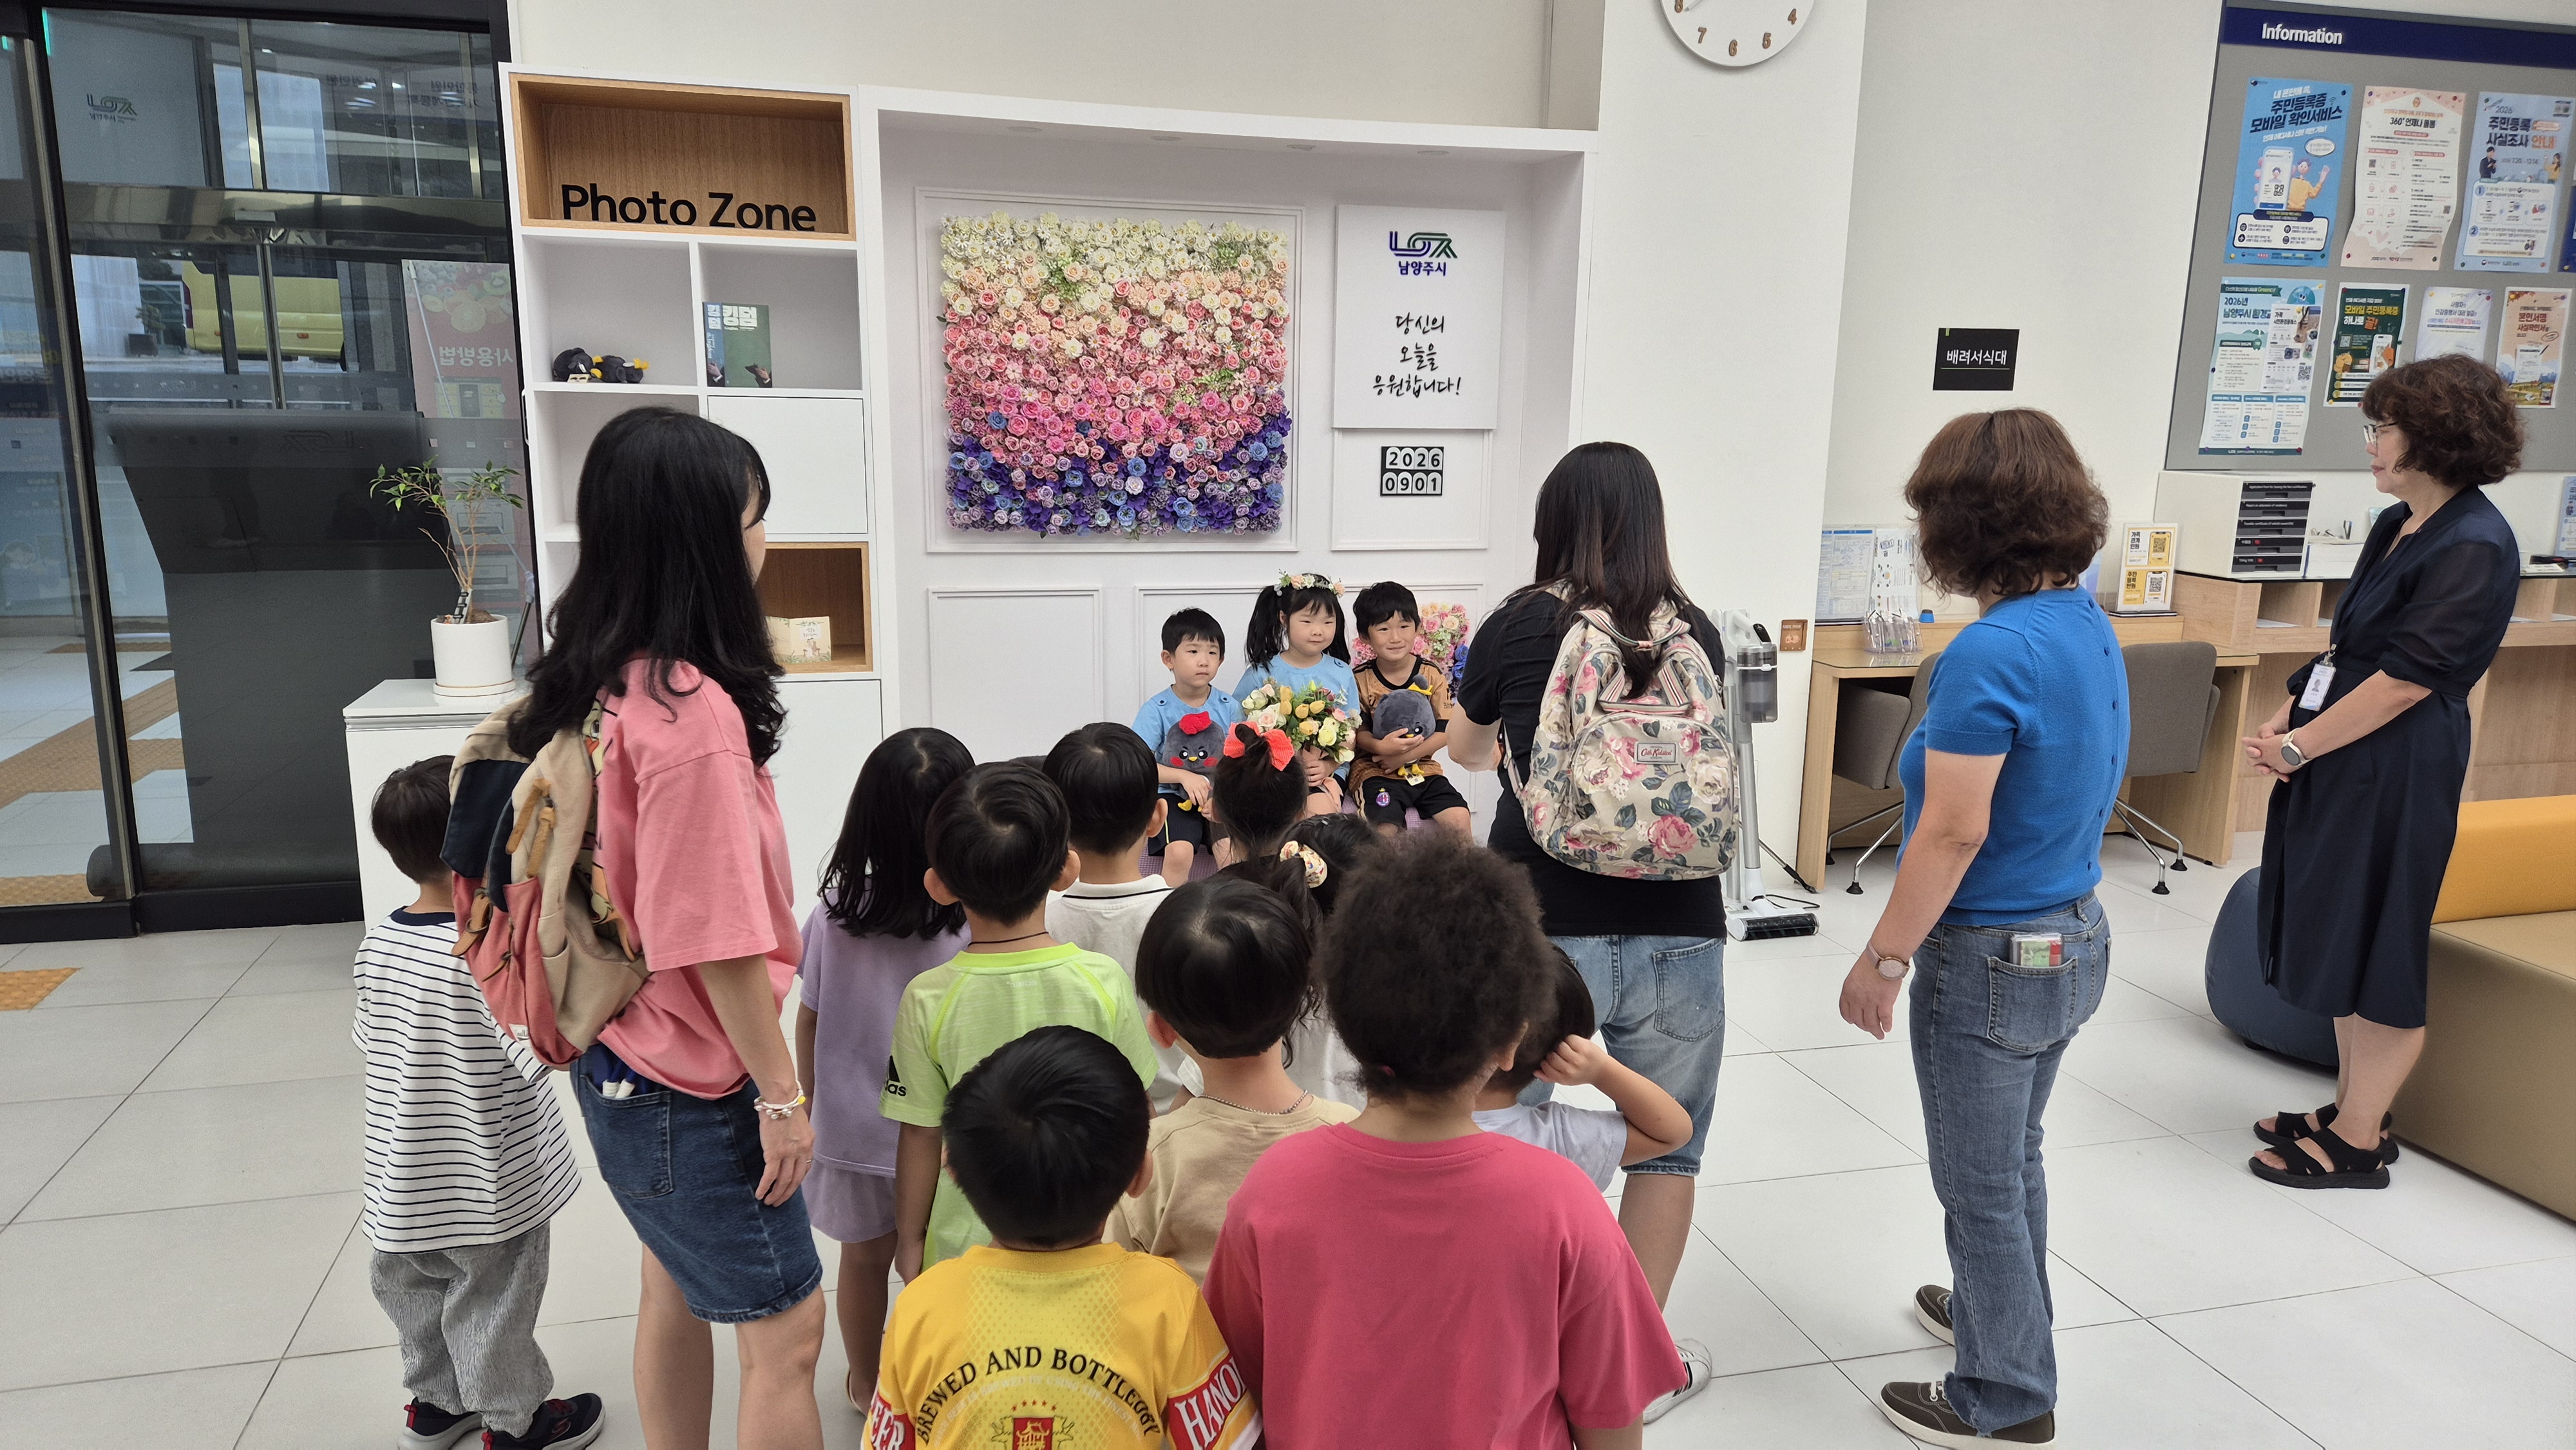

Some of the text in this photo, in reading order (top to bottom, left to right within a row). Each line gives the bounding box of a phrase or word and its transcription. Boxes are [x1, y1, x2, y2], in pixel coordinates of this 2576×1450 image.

[1788, 8, 1797, 25] 4
[1698, 27, 1707, 44] 7
[1762, 32, 1771, 49] 5
[2261, 23, 2344, 46] Information
[1728, 39, 1738, 57] 6
[2271, 92, 2327, 115] 주민등록증
[2249, 106, 2342, 133] 모바일 확인서비스
[2405, 118, 2423, 127] 언제나
[2488, 116, 2532, 132] 주민등록
[2486, 132, 2555, 149] 사실조사 안내
[562, 183, 817, 232] Photo Zone
[1397, 260, 1447, 277] 남양주시
[2224, 297, 2248, 306] 2026년
[2344, 305, 2399, 315] 모바일 주민등록증
[722, 305, 758, 327] 킹덤
[2223, 308, 2252, 319] 남양주시
[2344, 315, 2364, 325] 하나로
[2519, 312, 2547, 323] 본인서명
[1396, 312, 1445, 335] 당신의
[1399, 342, 1439, 372] 오늘을
[1946, 348, 2007, 366] 배려서식대
[1372, 373, 1461, 399] 응원합니다!
[1388, 451, 1441, 469] 2026
[1385, 476, 1438, 493] 0901
[917, 1362, 977, 1447] BREWED
[985, 1346, 1042, 1376] AND
[1175, 1355, 1247, 1450] HANOI
